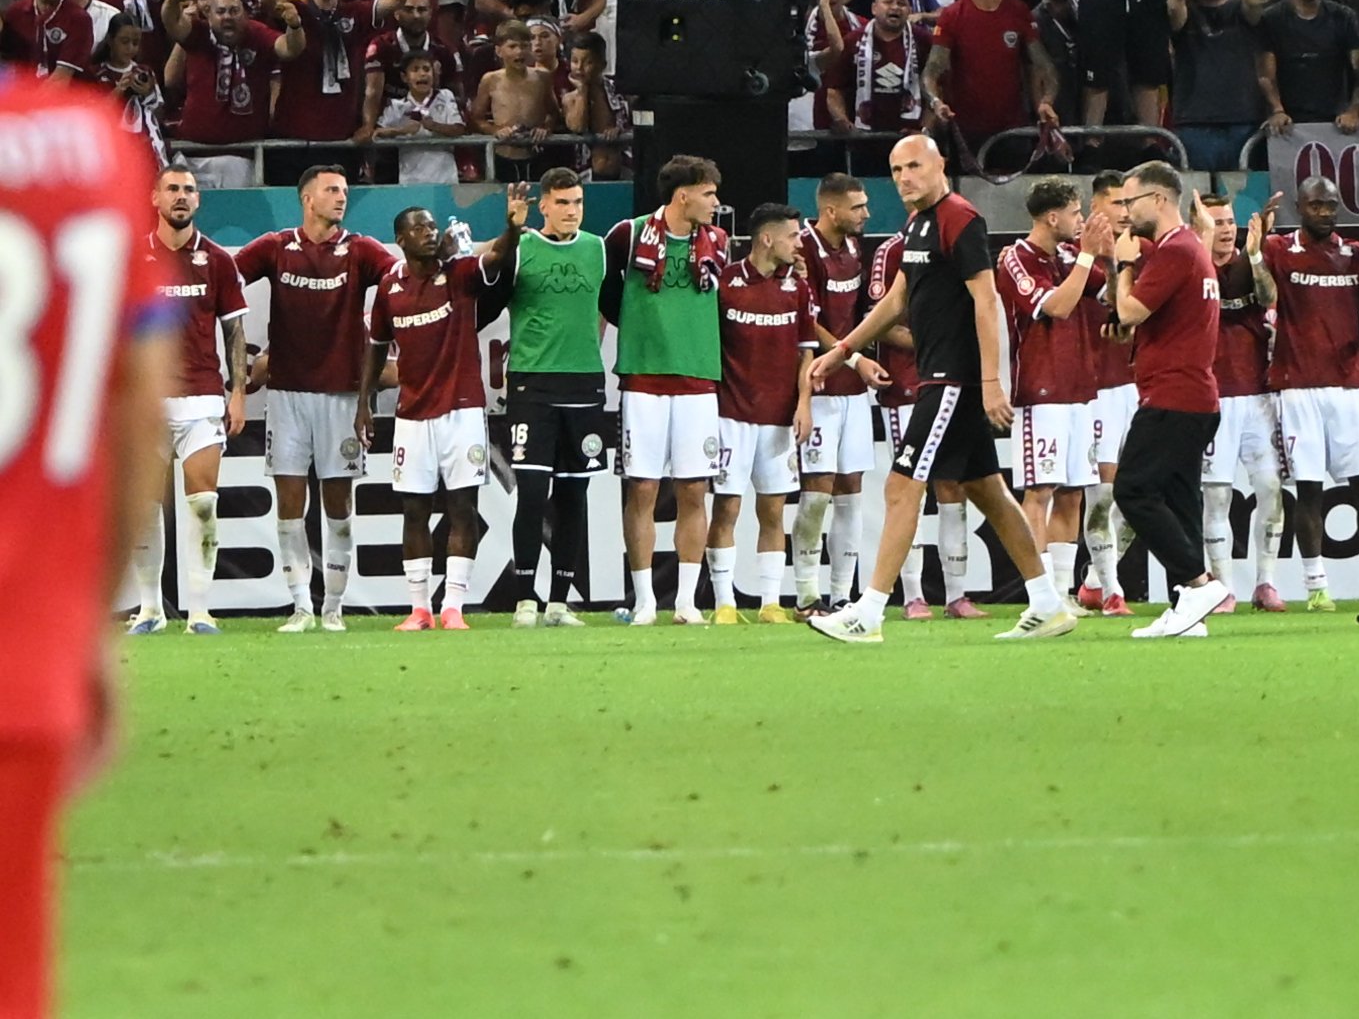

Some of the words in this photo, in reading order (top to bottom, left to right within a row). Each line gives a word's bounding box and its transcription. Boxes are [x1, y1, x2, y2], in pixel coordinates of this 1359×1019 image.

[157, 283, 208, 298] PERBET
[280, 271, 349, 292] SUPERBET
[392, 300, 455, 330] SUPERBET
[726, 307, 798, 326] SUPERBET
[510, 422, 529, 447] 16
[1037, 438, 1059, 458] 24
